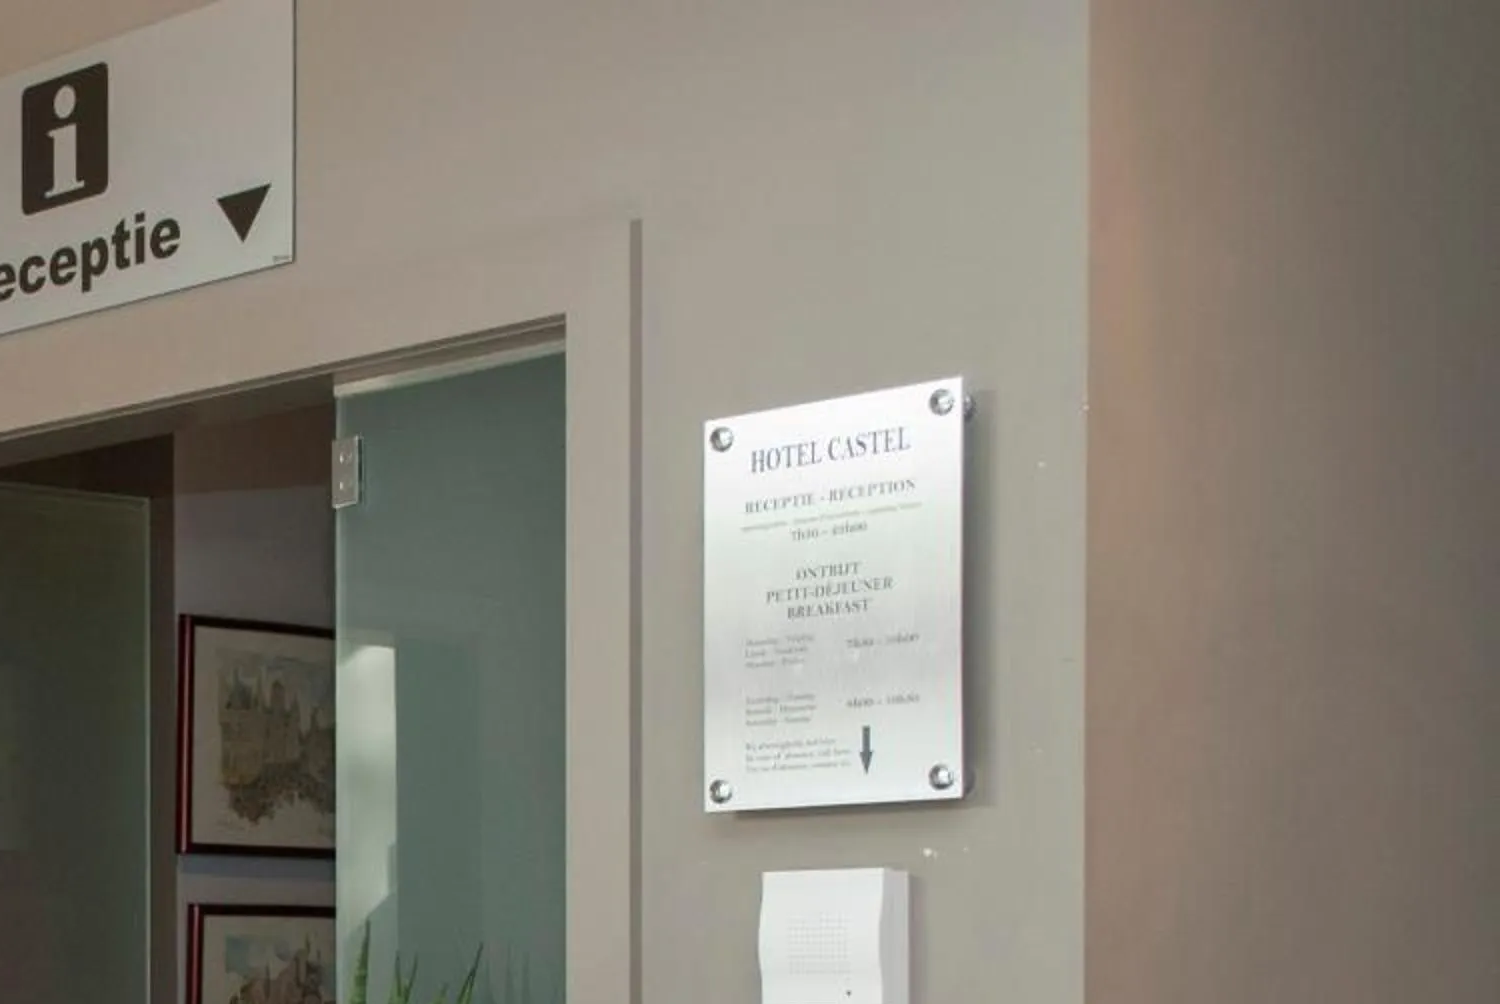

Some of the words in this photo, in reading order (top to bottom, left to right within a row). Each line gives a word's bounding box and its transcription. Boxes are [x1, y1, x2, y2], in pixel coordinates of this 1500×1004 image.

[44, 84, 86, 199] i
[750, 441, 822, 474] HOTEL
[828, 426, 912, 461] CASTEL
[745, 491, 815, 514] RECEPTIE
[787, 598, 872, 619] BREAKFAST
